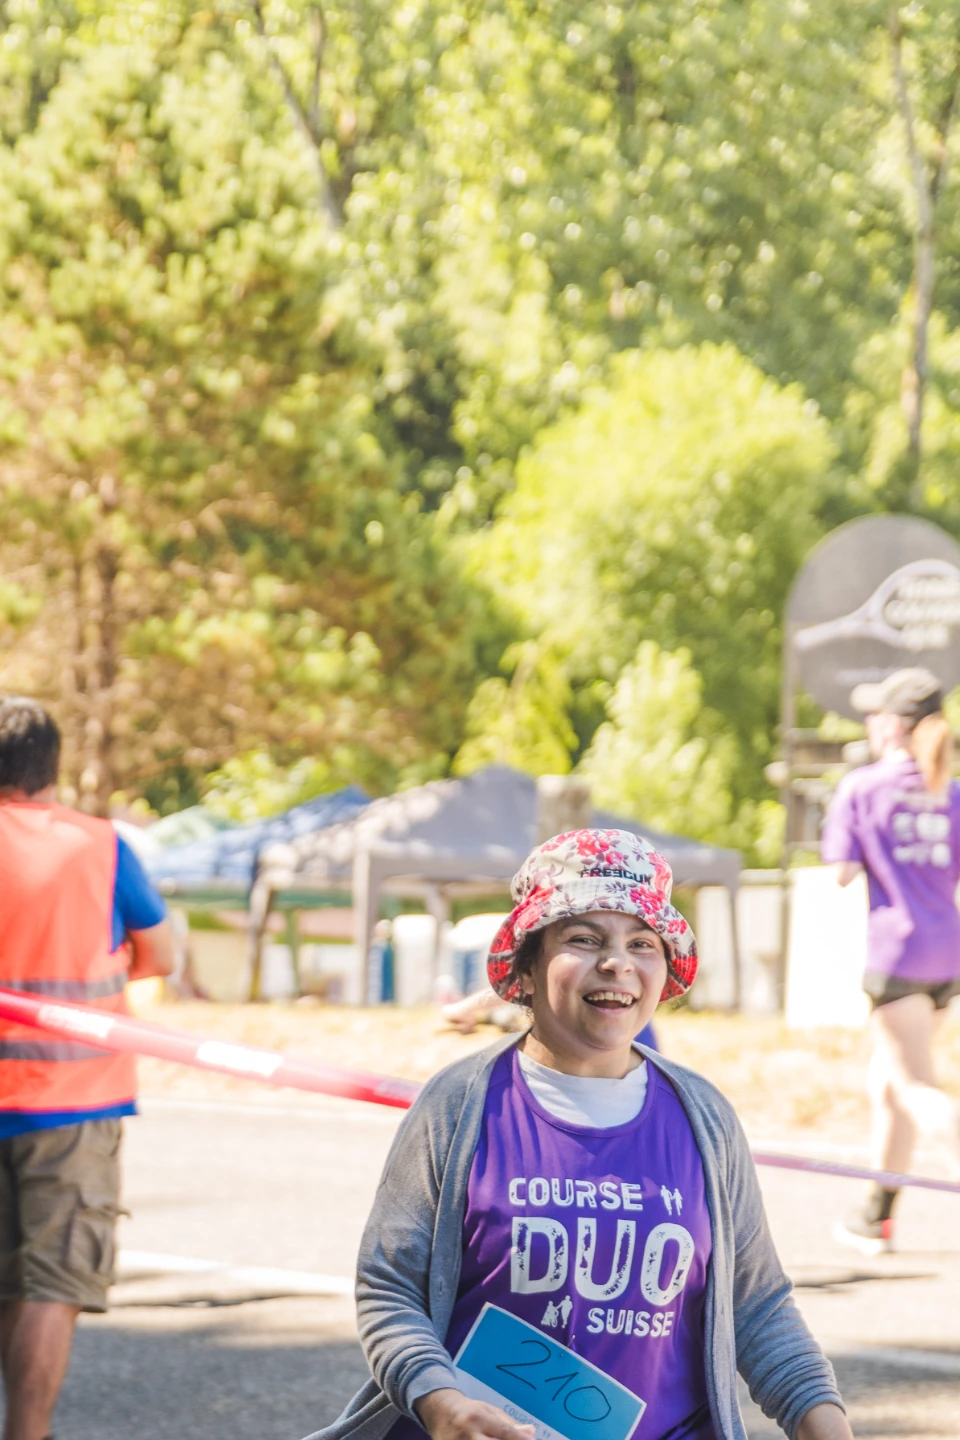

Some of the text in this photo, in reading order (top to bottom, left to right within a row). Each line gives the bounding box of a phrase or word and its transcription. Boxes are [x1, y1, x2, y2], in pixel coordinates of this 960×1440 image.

[509, 1177, 644, 1211] COURSE
[510, 1216, 695, 1306] DUO
[586, 1307, 675, 1337] SUISSE
[495, 1339, 612, 1422] 210
